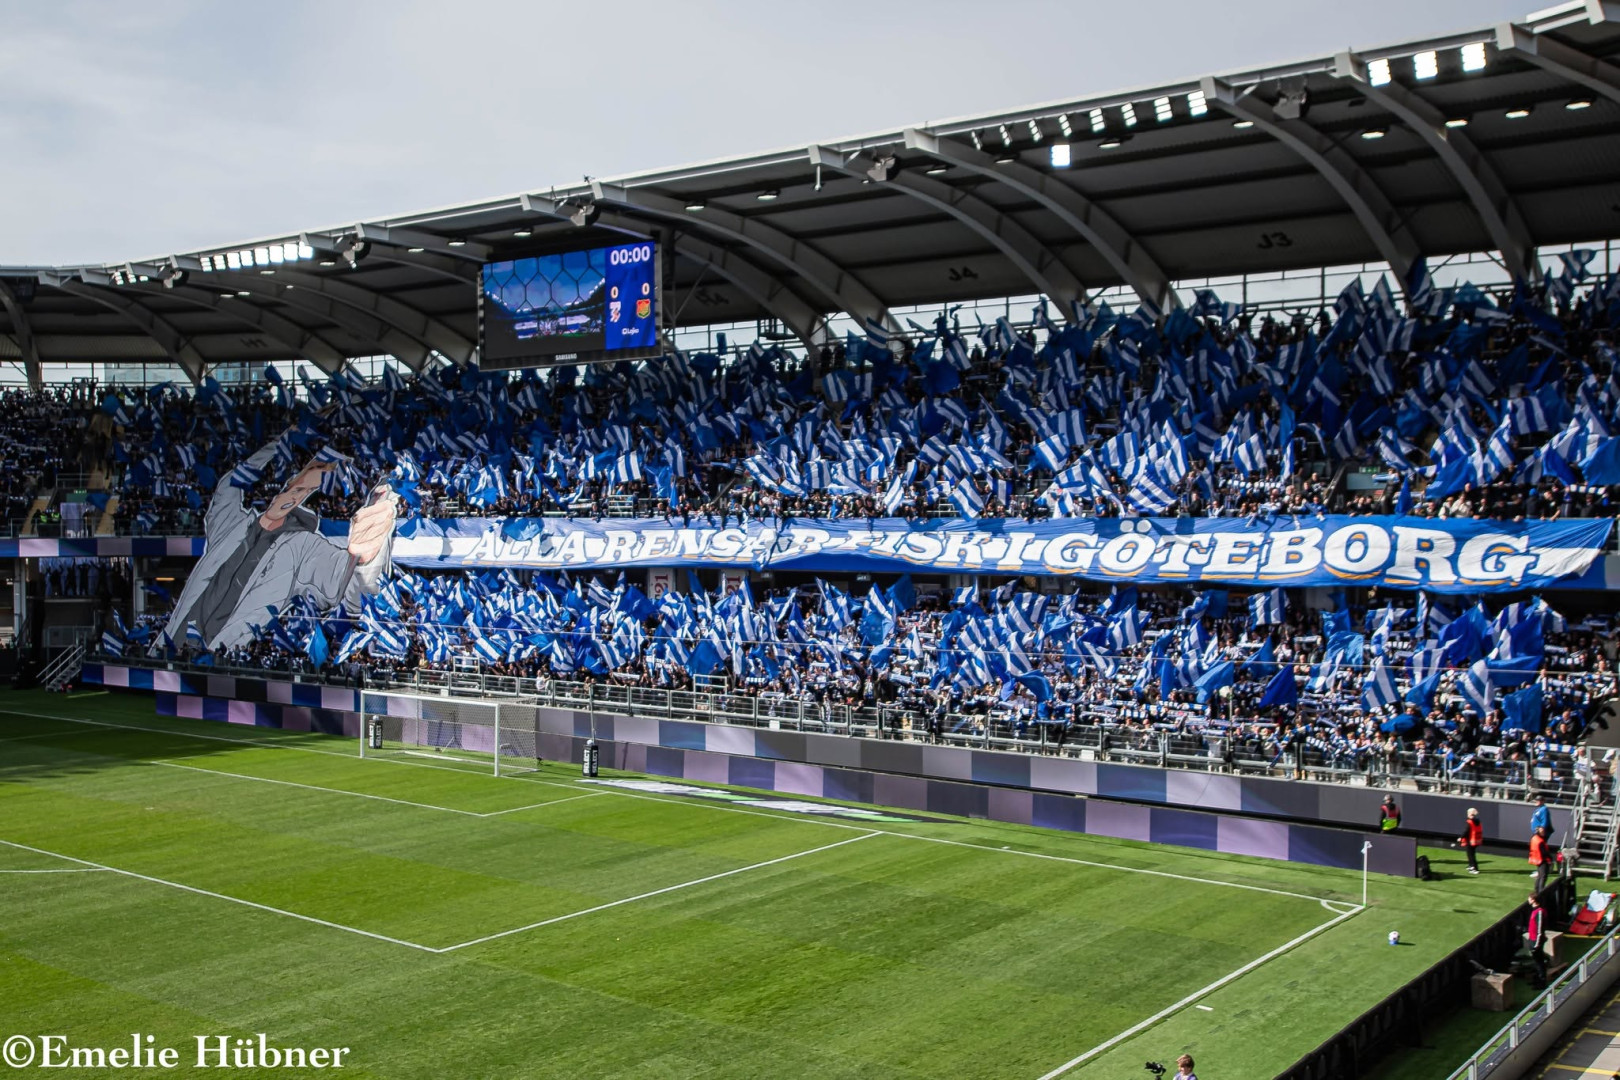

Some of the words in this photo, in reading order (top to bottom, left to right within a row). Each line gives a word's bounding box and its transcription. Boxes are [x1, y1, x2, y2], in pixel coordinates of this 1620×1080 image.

[1257, 231, 1293, 249] J3
[610, 245, 650, 265] 00:00
[948, 266, 980, 281] J4
[610, 286, 619, 299] 0
[641, 282, 650, 296] 0
[555, 353, 578, 361] SAMSUNG
[464, 530, 588, 565] ALLA
[603, 527, 832, 563] RENSAR
[843, 529, 994, 568] FISK
[997, 531, 1036, 571] I
[1044, 519, 1532, 586] GÖTEBORG
